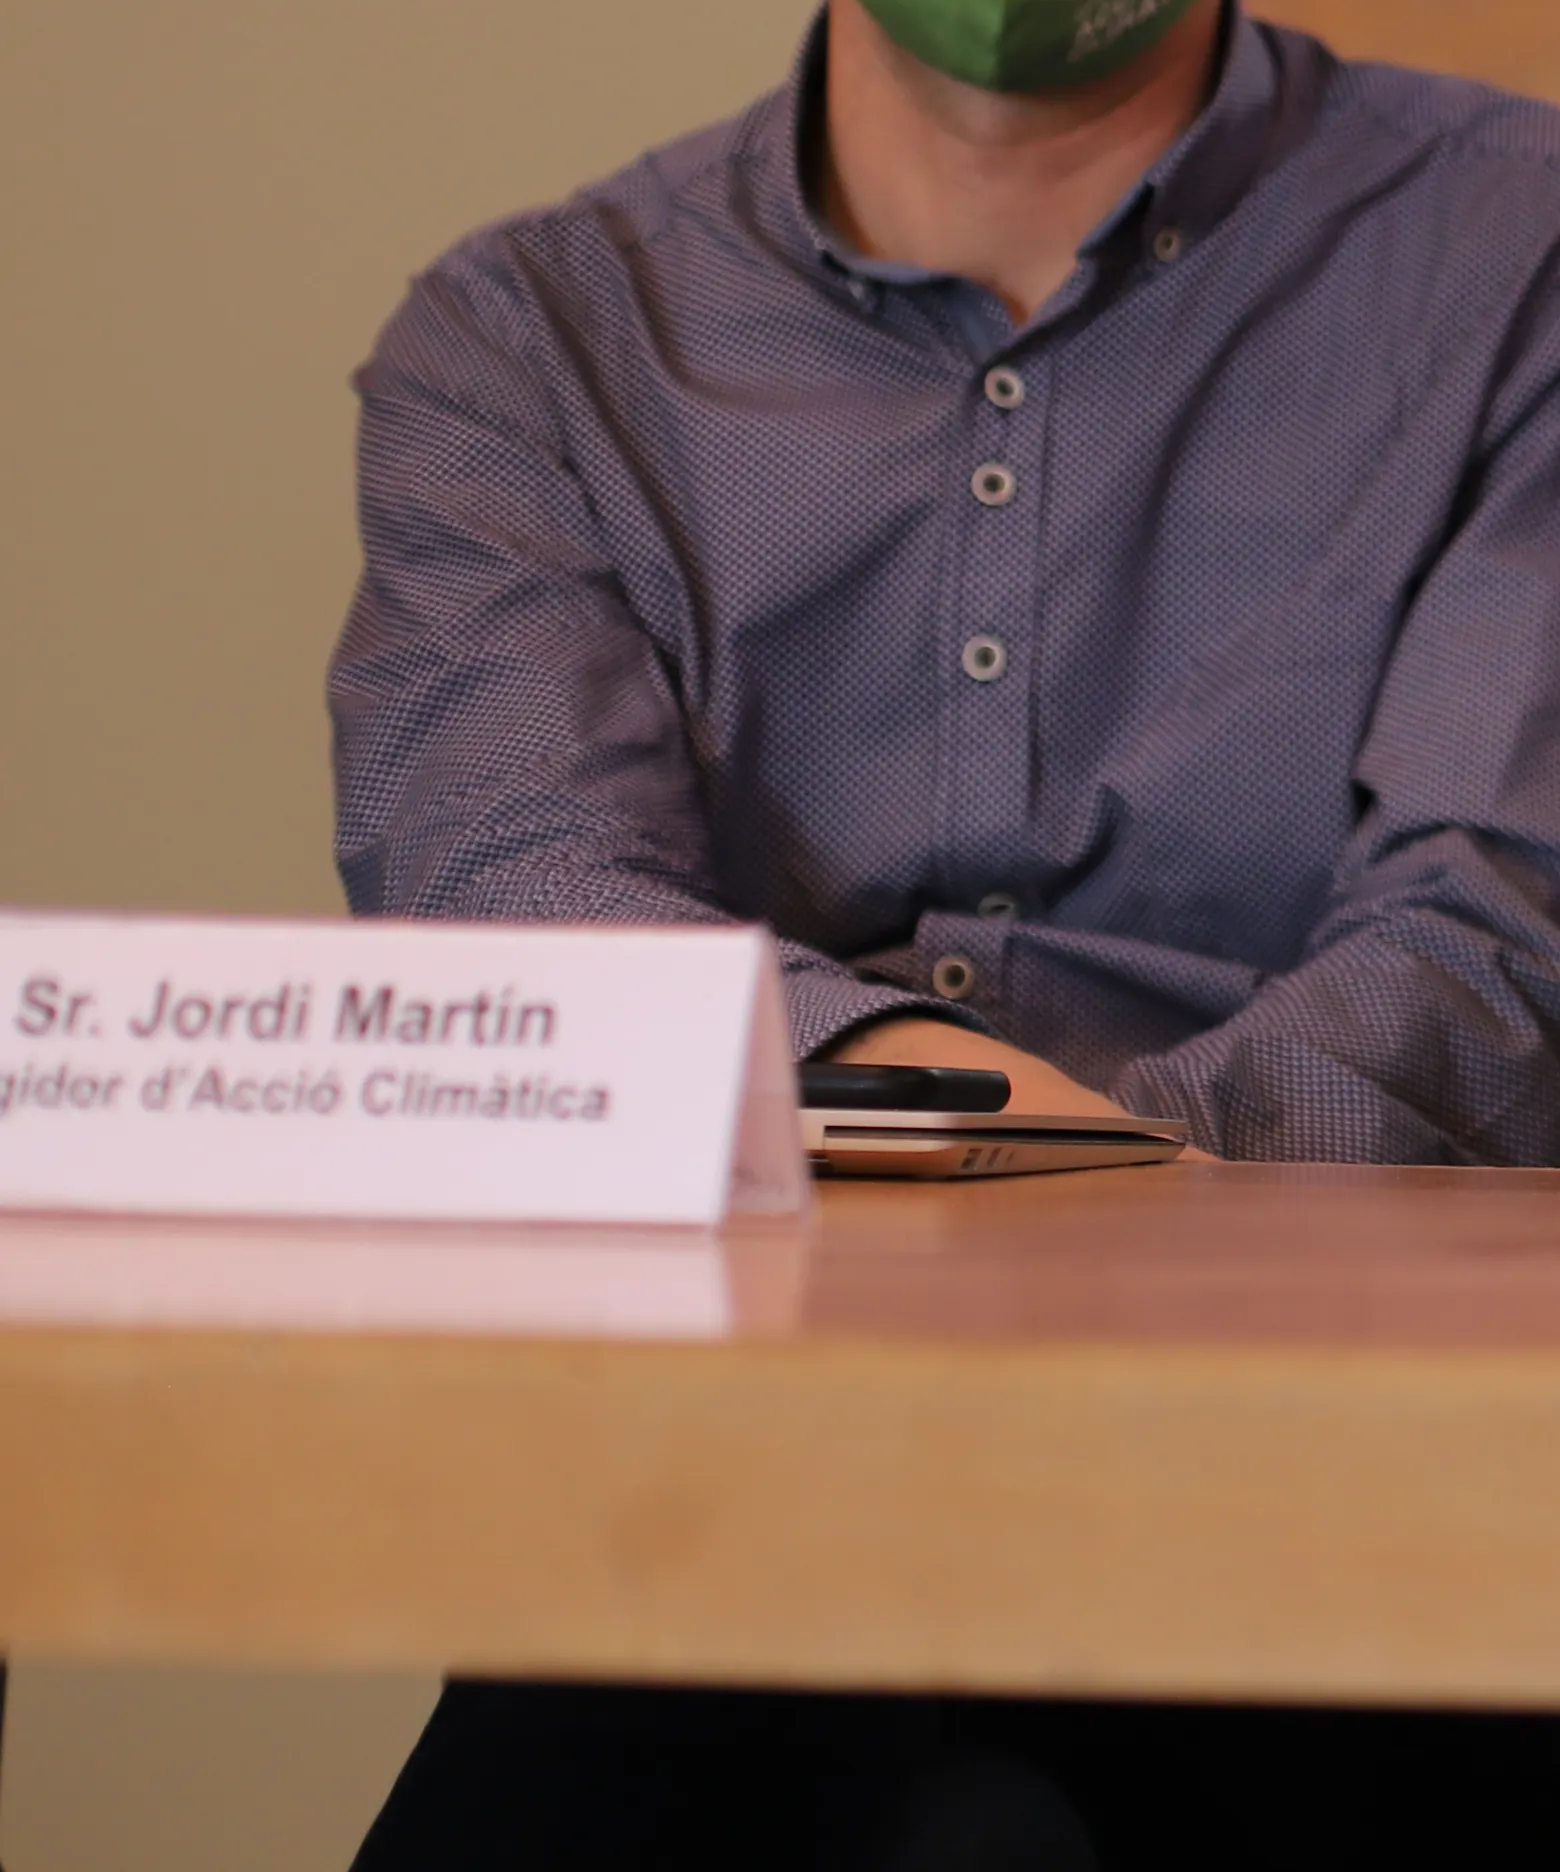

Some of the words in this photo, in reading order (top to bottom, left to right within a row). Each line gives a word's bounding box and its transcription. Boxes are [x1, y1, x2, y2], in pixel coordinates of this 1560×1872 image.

[14, 975, 103, 1037] Sr.
[128, 977, 312, 1041] Jordi
[332, 983, 558, 1046] Martín
[359, 1068, 611, 1122] Climàtica
